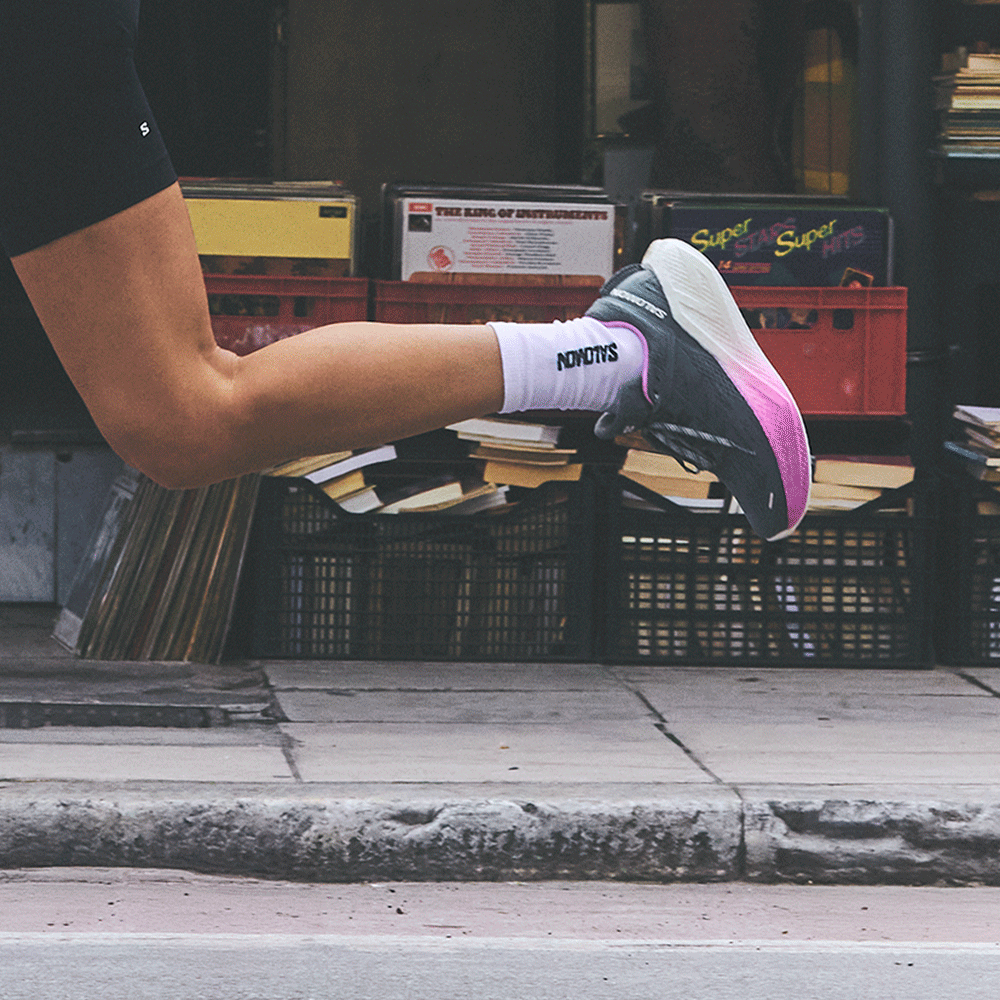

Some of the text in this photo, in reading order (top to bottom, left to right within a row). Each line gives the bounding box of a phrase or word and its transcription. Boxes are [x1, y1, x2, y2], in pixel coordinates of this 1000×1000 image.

[435, 206, 462, 217] THE
[463, 207, 496, 218] KING
[496, 208, 515, 218] OF
[516, 208, 609, 221] INSTRUMENTS
[690, 217, 752, 252] Super
[773, 218, 837, 258] Super
[822, 225, 865, 259] HITS
[556, 341, 619, 371] SALOMON
